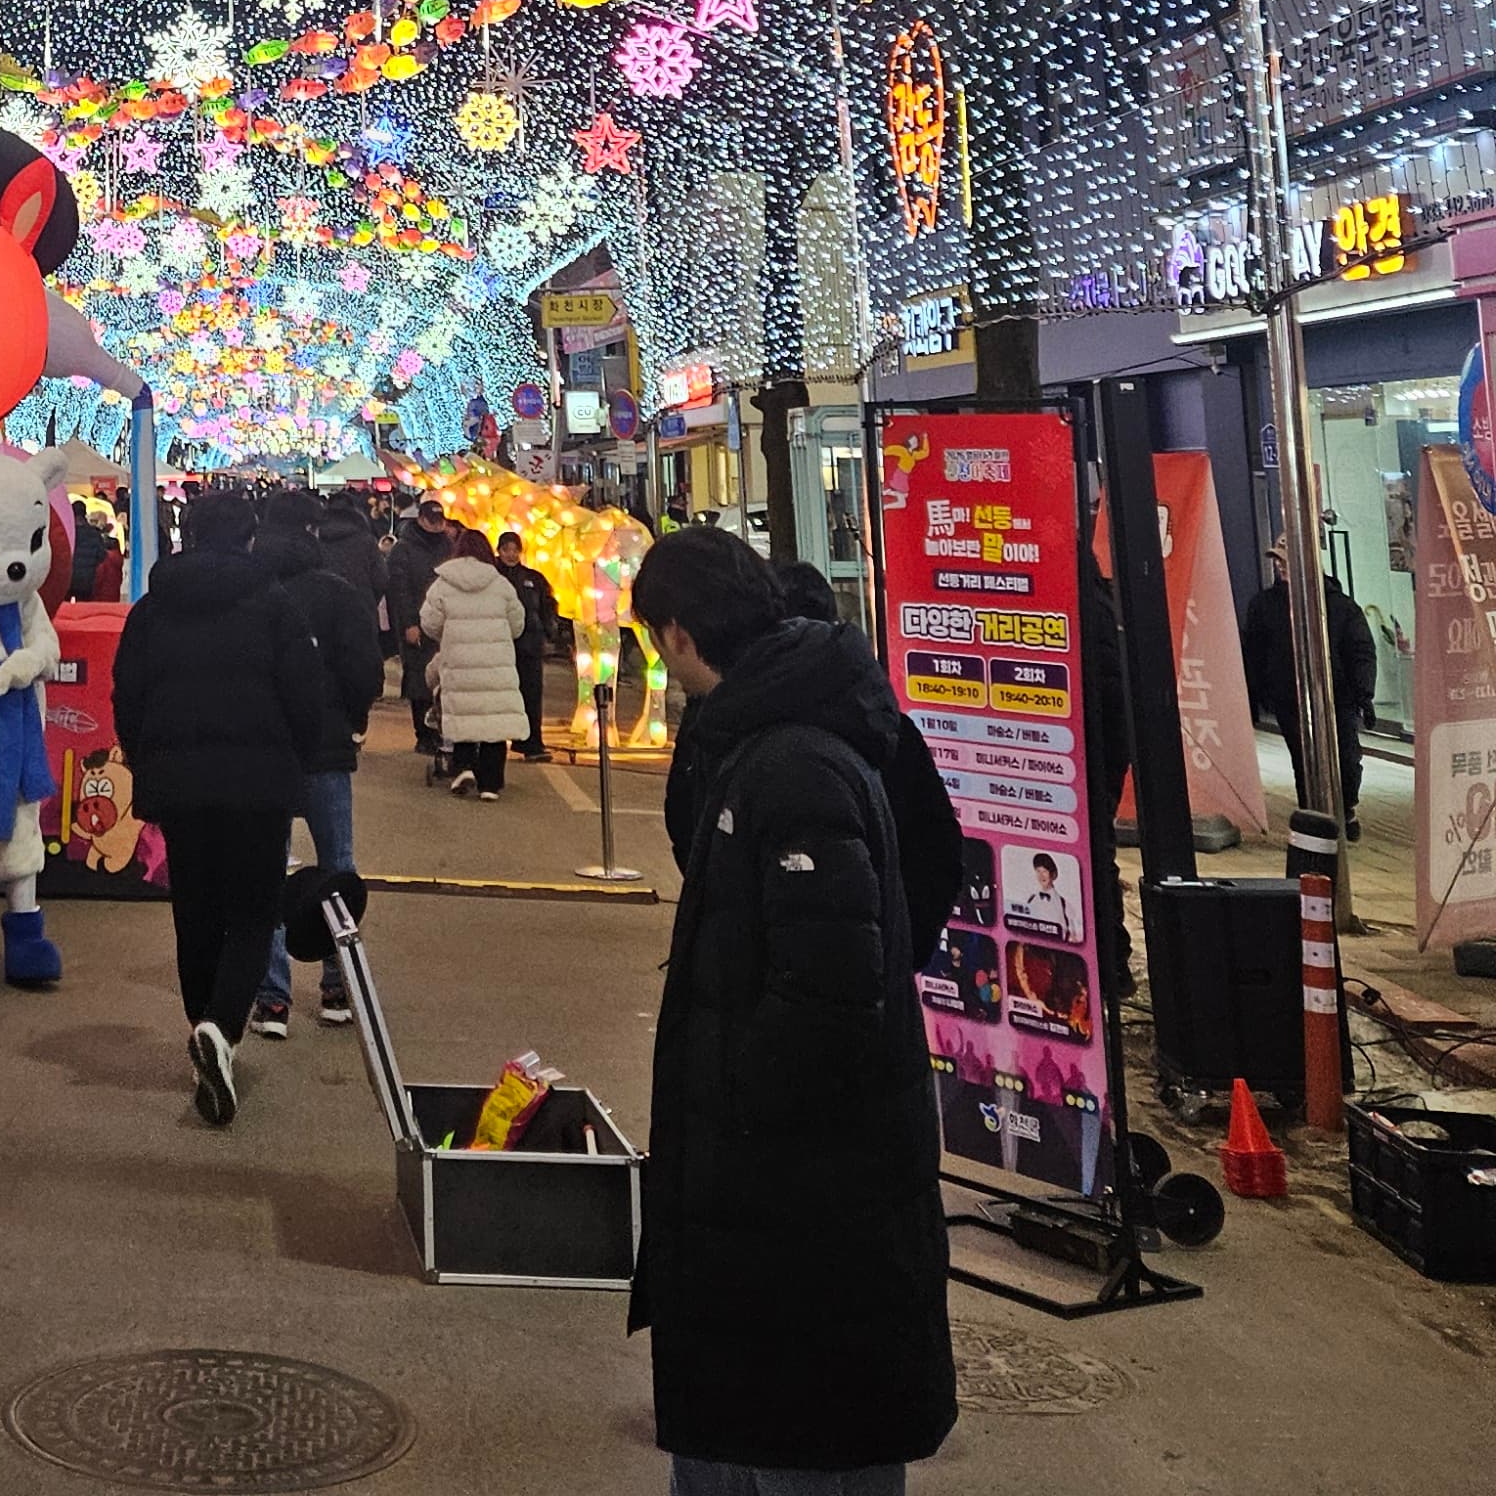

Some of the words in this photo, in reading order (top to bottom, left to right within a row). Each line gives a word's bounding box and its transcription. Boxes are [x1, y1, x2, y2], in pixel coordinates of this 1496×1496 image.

[1334, 194, 1405, 282] 안경
[974, 504, 1032, 531] 선등
[938, 572, 982, 590] 선등거리
[903, 606, 972, 641] 다양한
[975, 610, 1068, 649] 거리공연
[932, 658, 962, 676] 1회차
[1013, 666, 1046, 684] 2회차
[987, 724, 1014, 740] 마술쇼
[975, 752, 1021, 770] 미니서커스
[989, 782, 1017, 798] 마술쇼
[977, 809, 1023, 829] 미니서커스
